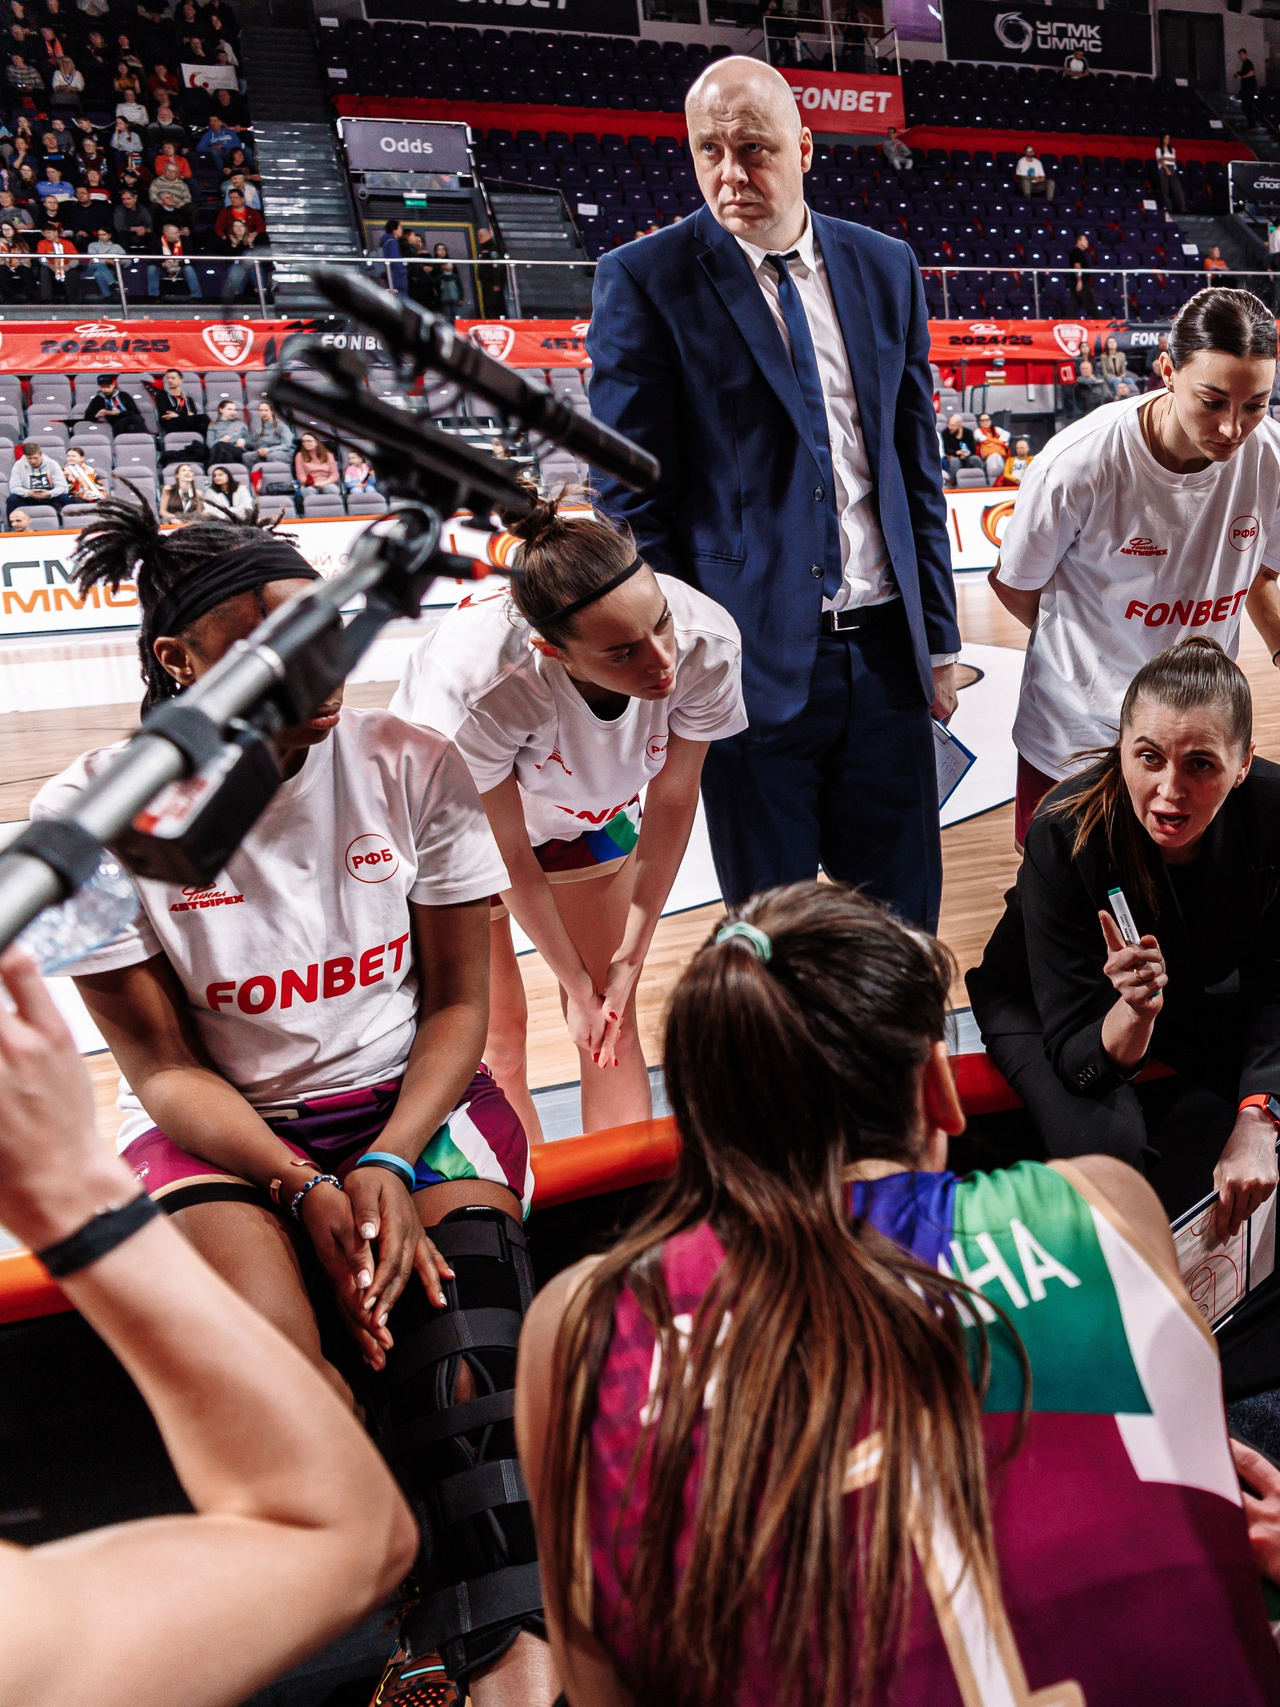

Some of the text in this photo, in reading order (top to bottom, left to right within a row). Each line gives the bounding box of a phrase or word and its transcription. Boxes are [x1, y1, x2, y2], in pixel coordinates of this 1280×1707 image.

[1036, 21, 1101, 39] УГМК
[1037, 36, 1102, 52] UMMC
[380, 137, 434, 154] Odds
[40, 339, 170, 354] 2024/25
[949, 336, 1033, 345] 2024/25
[1232, 527, 1256, 539] РФБ
[1124, 588, 1249, 627] FONBET
[352, 848, 393, 870] РФБ
[206, 932, 409, 1015] FONBET
